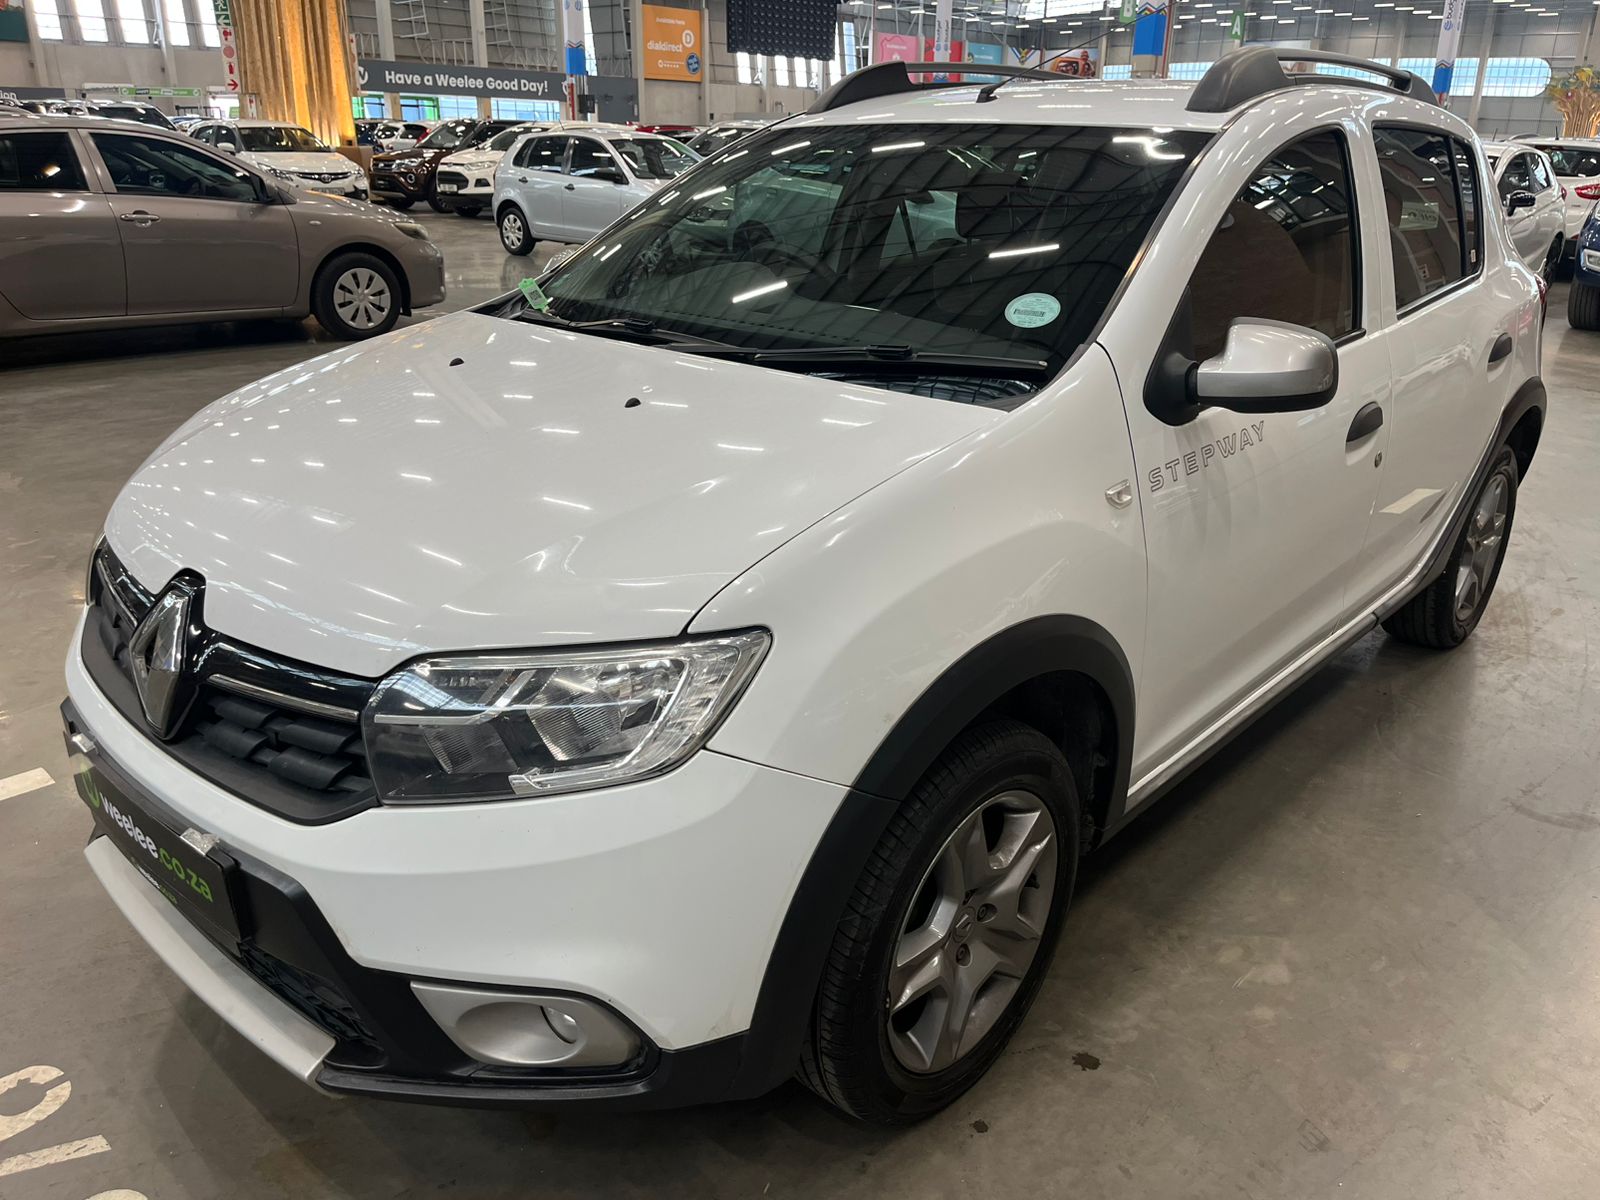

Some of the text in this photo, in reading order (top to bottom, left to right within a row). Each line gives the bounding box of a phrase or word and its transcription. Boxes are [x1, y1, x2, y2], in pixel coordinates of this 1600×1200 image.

[1232, 15, 1240, 36] A
[647, 40, 683, 53] dialdirect
[385, 71, 548, 96] Have a Weelee Good Day!
[1148, 420, 1264, 492] STEPWAY
[100, 792, 213, 902] weelee.co.za
